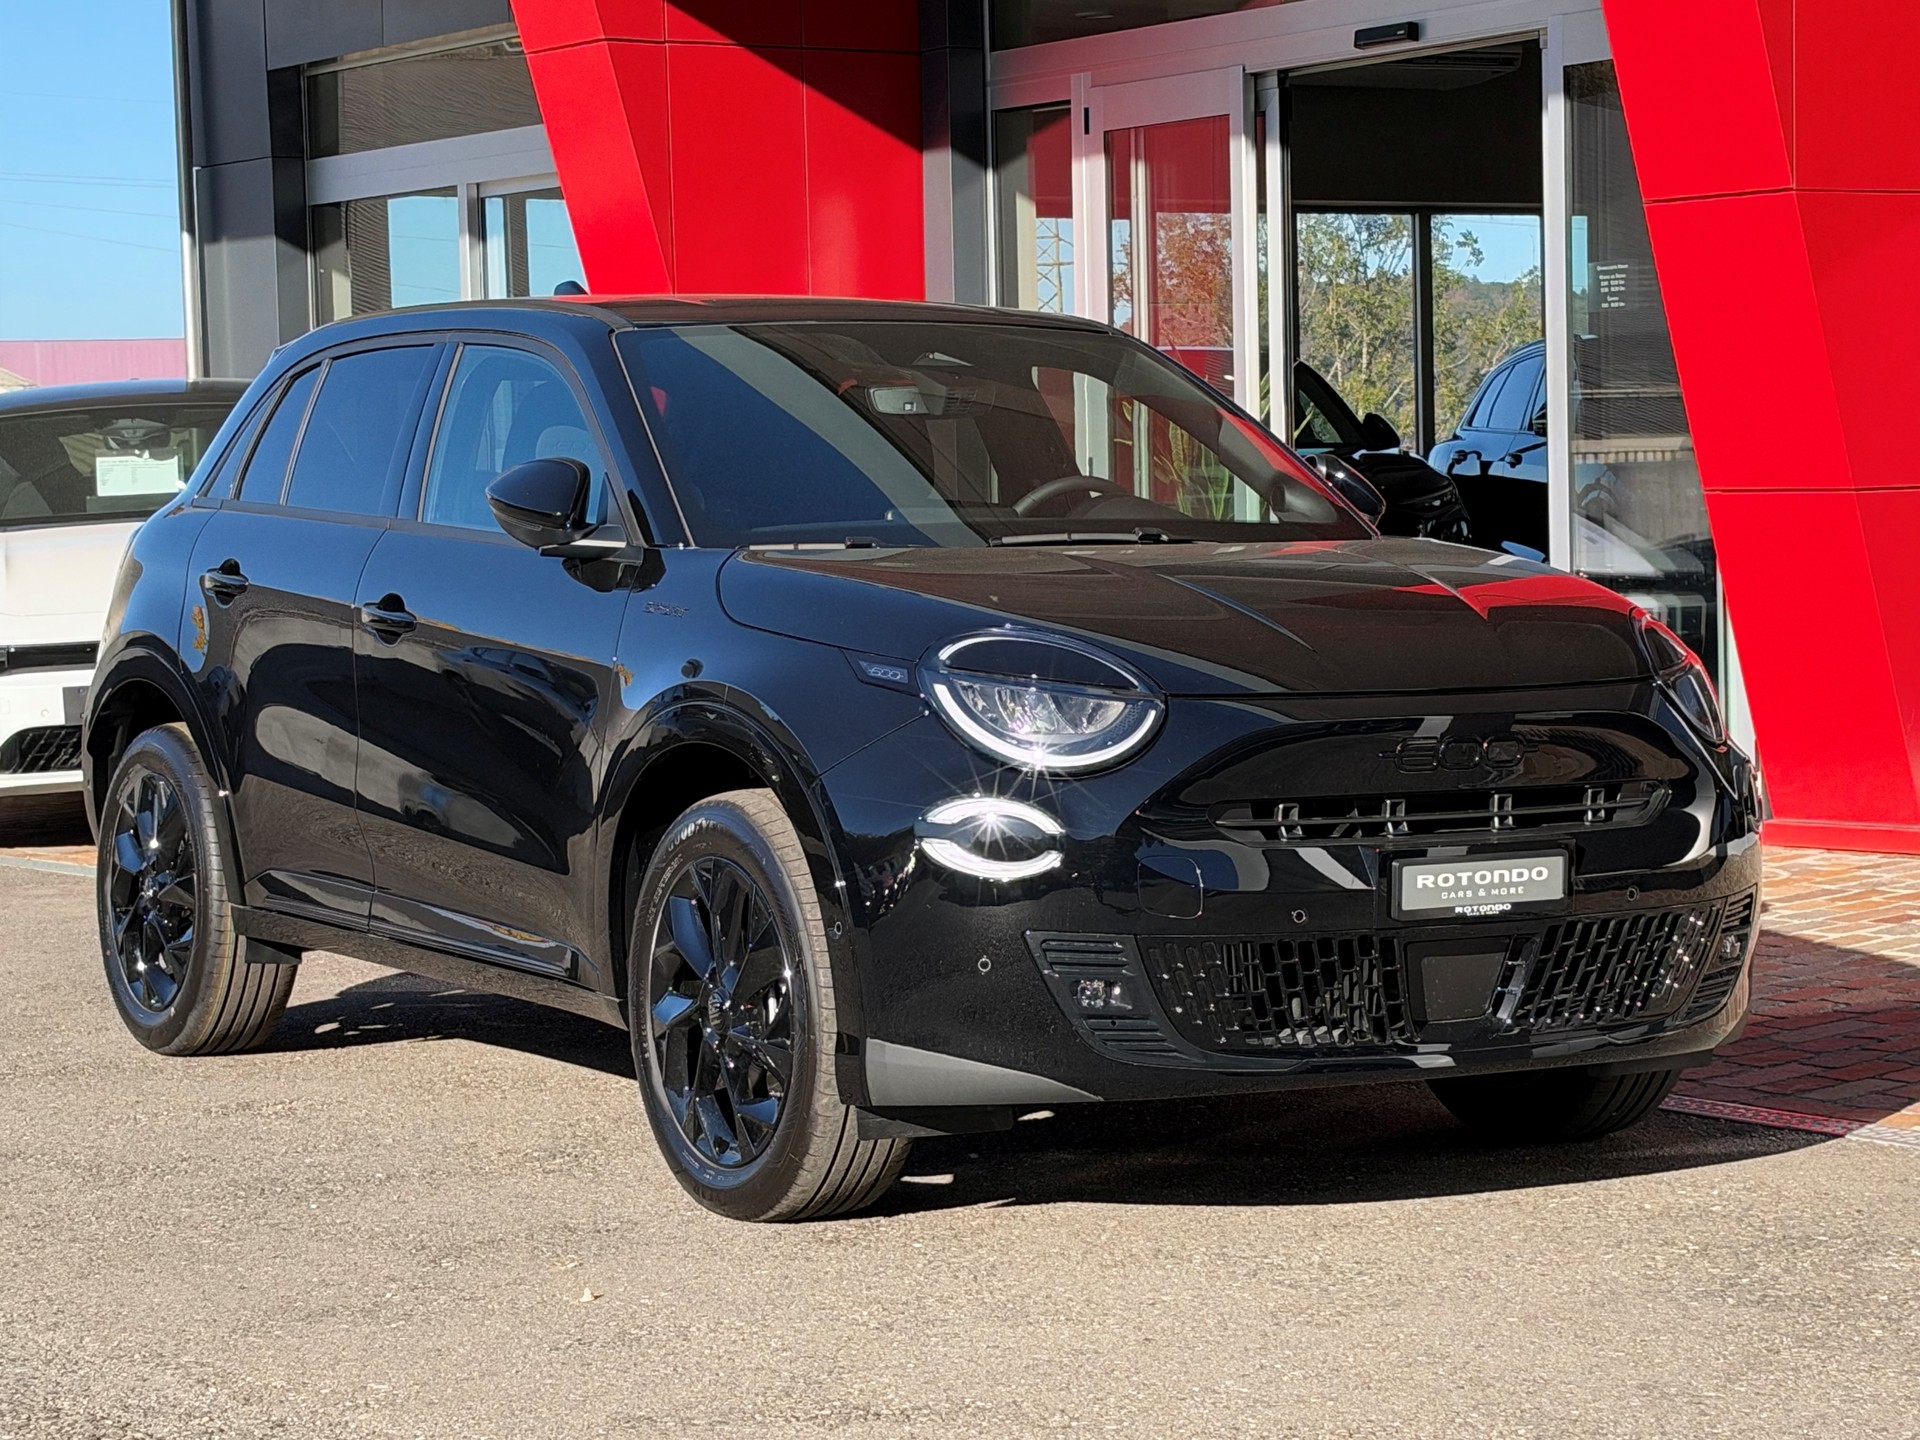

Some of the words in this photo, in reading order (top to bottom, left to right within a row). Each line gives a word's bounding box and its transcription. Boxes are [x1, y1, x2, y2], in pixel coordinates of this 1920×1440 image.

[870, 666, 901, 680] 600
[1395, 735, 1526, 774] 600
[1417, 866, 1549, 889] ROTONDO
[1441, 889, 1473, 899] CARS
[1478, 887, 1487, 897] &
[1491, 886, 1525, 896] MORE
[1454, 903, 1512, 913] ROTONDO
